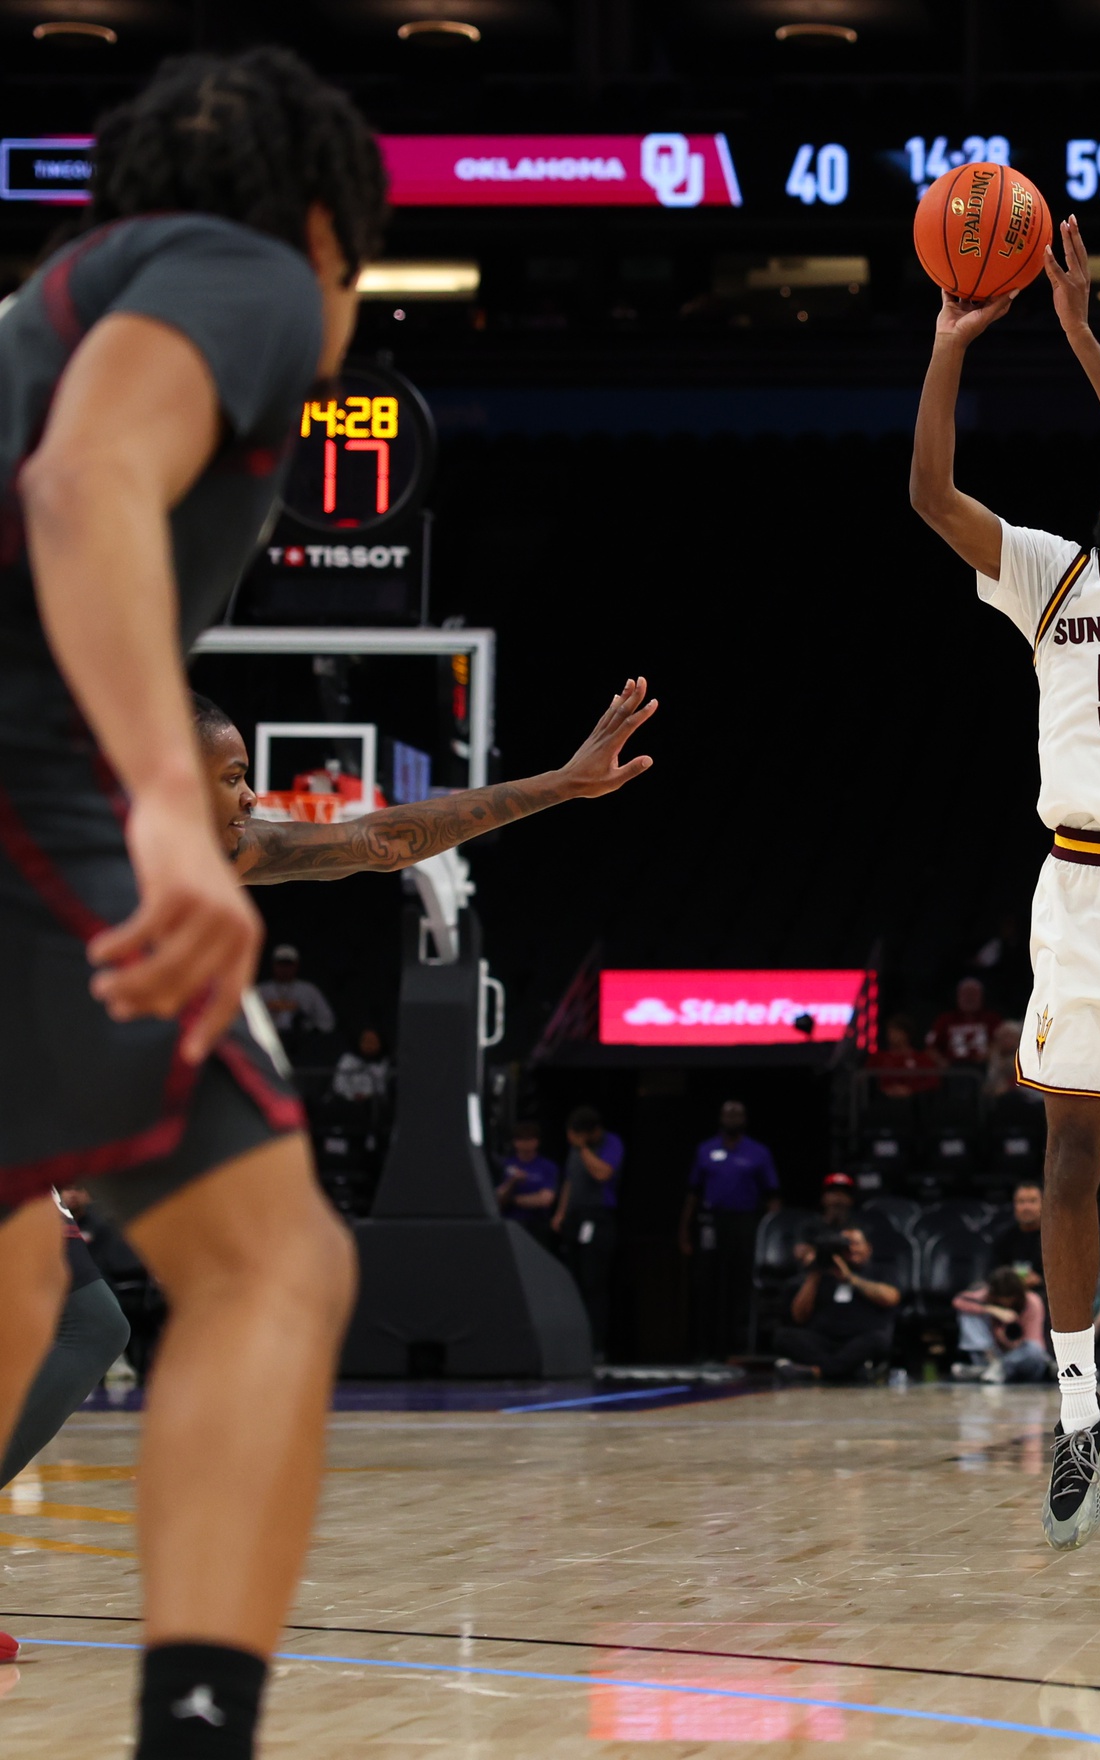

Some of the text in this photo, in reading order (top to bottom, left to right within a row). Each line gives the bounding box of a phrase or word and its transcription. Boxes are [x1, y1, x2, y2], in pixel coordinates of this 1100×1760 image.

[453, 157, 627, 182] OKLAHOMA
[786, 143, 849, 204] 40
[959, 170, 996, 257] SPALDING
[999, 181, 1026, 259] LEGACY
[300, 396, 398, 438] 14:28
[324, 440, 389, 514] 17
[306, 545, 410, 568] TISSOT
